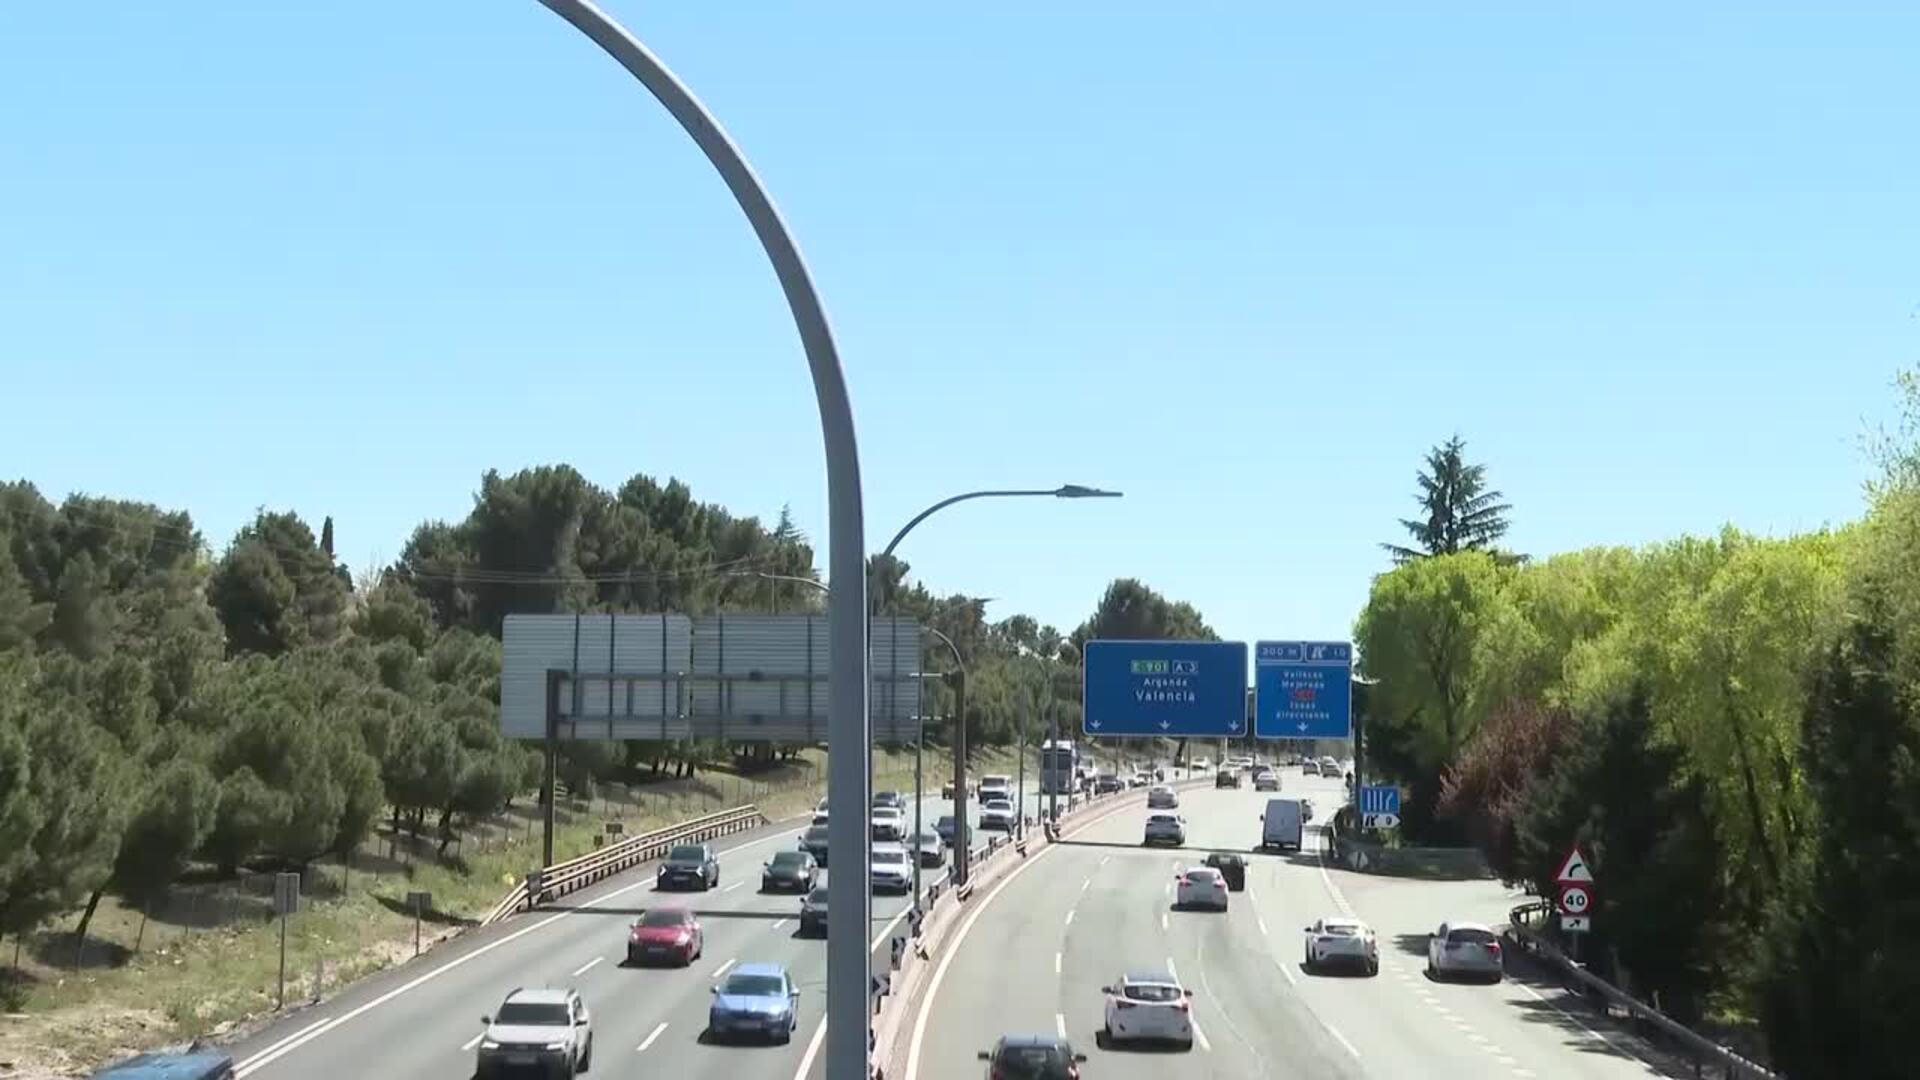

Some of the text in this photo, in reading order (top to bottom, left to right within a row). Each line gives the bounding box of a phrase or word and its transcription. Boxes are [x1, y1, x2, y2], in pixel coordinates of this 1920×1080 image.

[1175, 662, 1196, 673] A-3
[1143, 677, 1188, 688] Arganda
[1135, 689, 1195, 702] Valencia
[1566, 895, 1585, 906] 40
